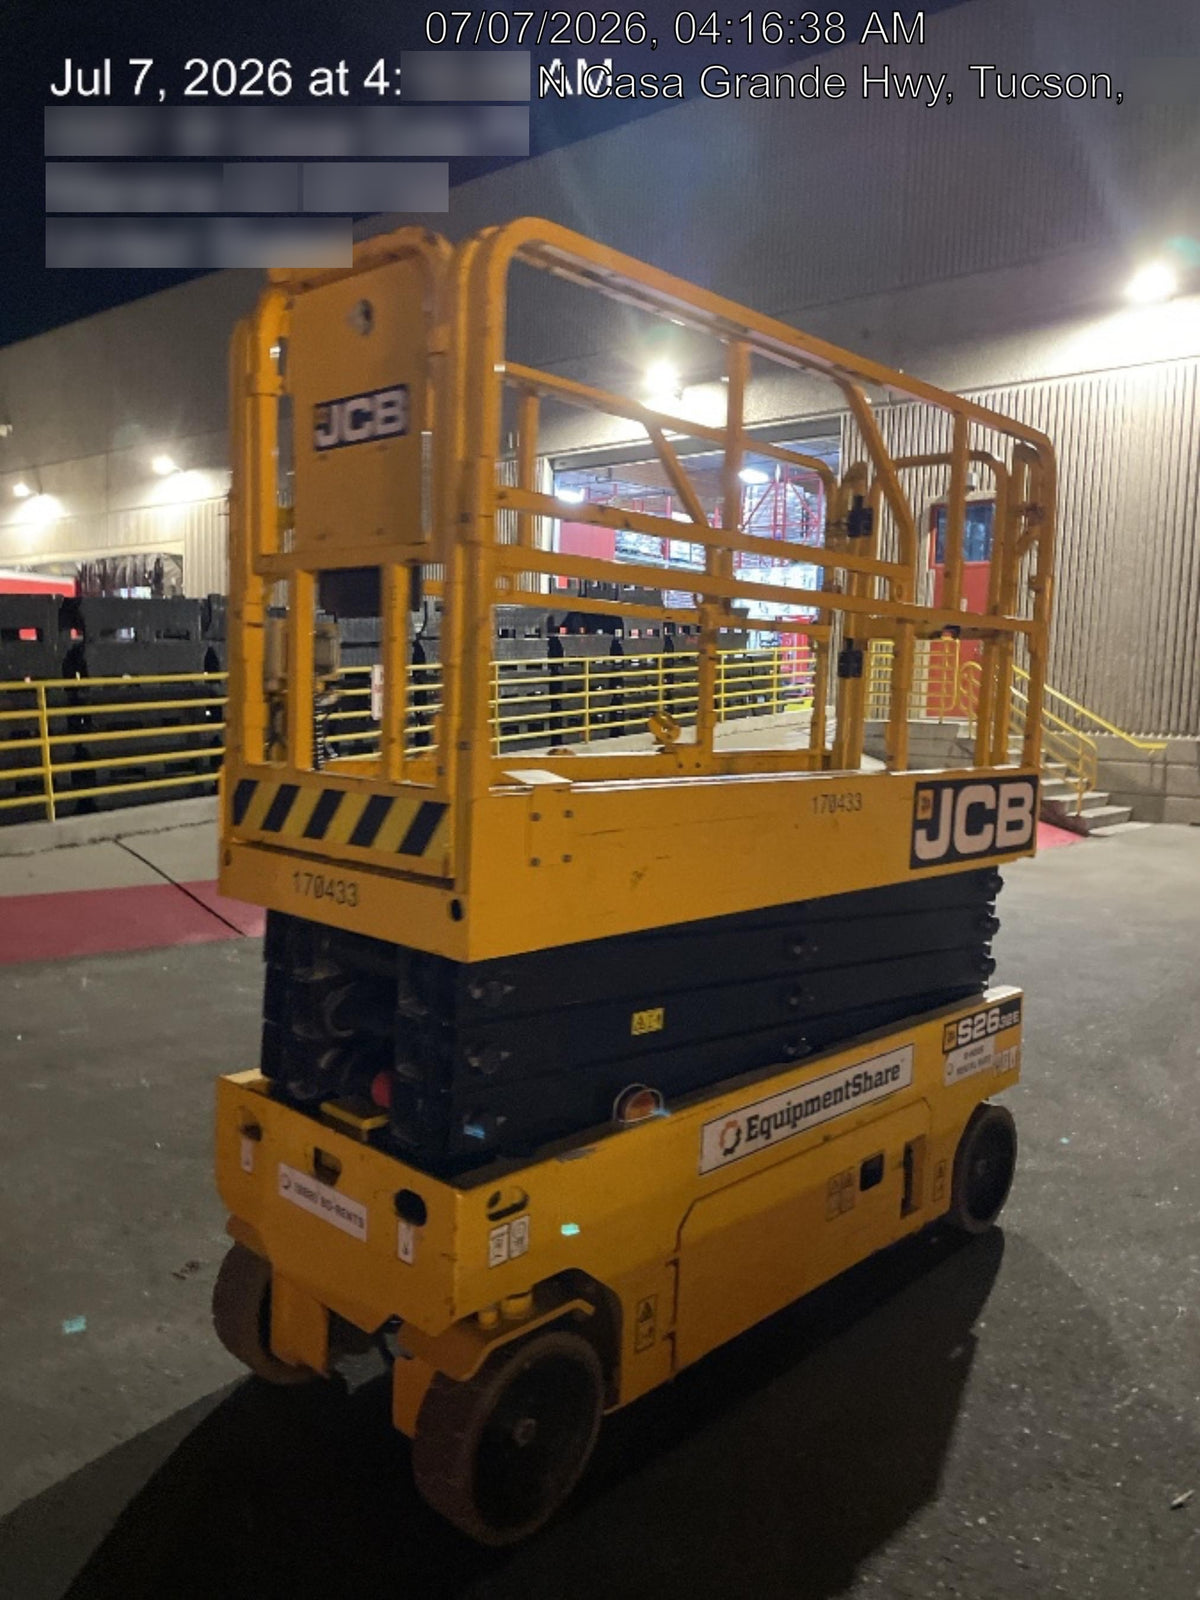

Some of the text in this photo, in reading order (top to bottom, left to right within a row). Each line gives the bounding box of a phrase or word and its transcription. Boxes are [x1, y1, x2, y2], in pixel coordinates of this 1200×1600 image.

[315, 389, 405, 447] JCB
[811, 792, 863, 815] 170433
[915, 782, 1035, 860] JCB
[293, 871, 358, 908] 170433
[745, 1063, 901, 1141] EquipmentShare
